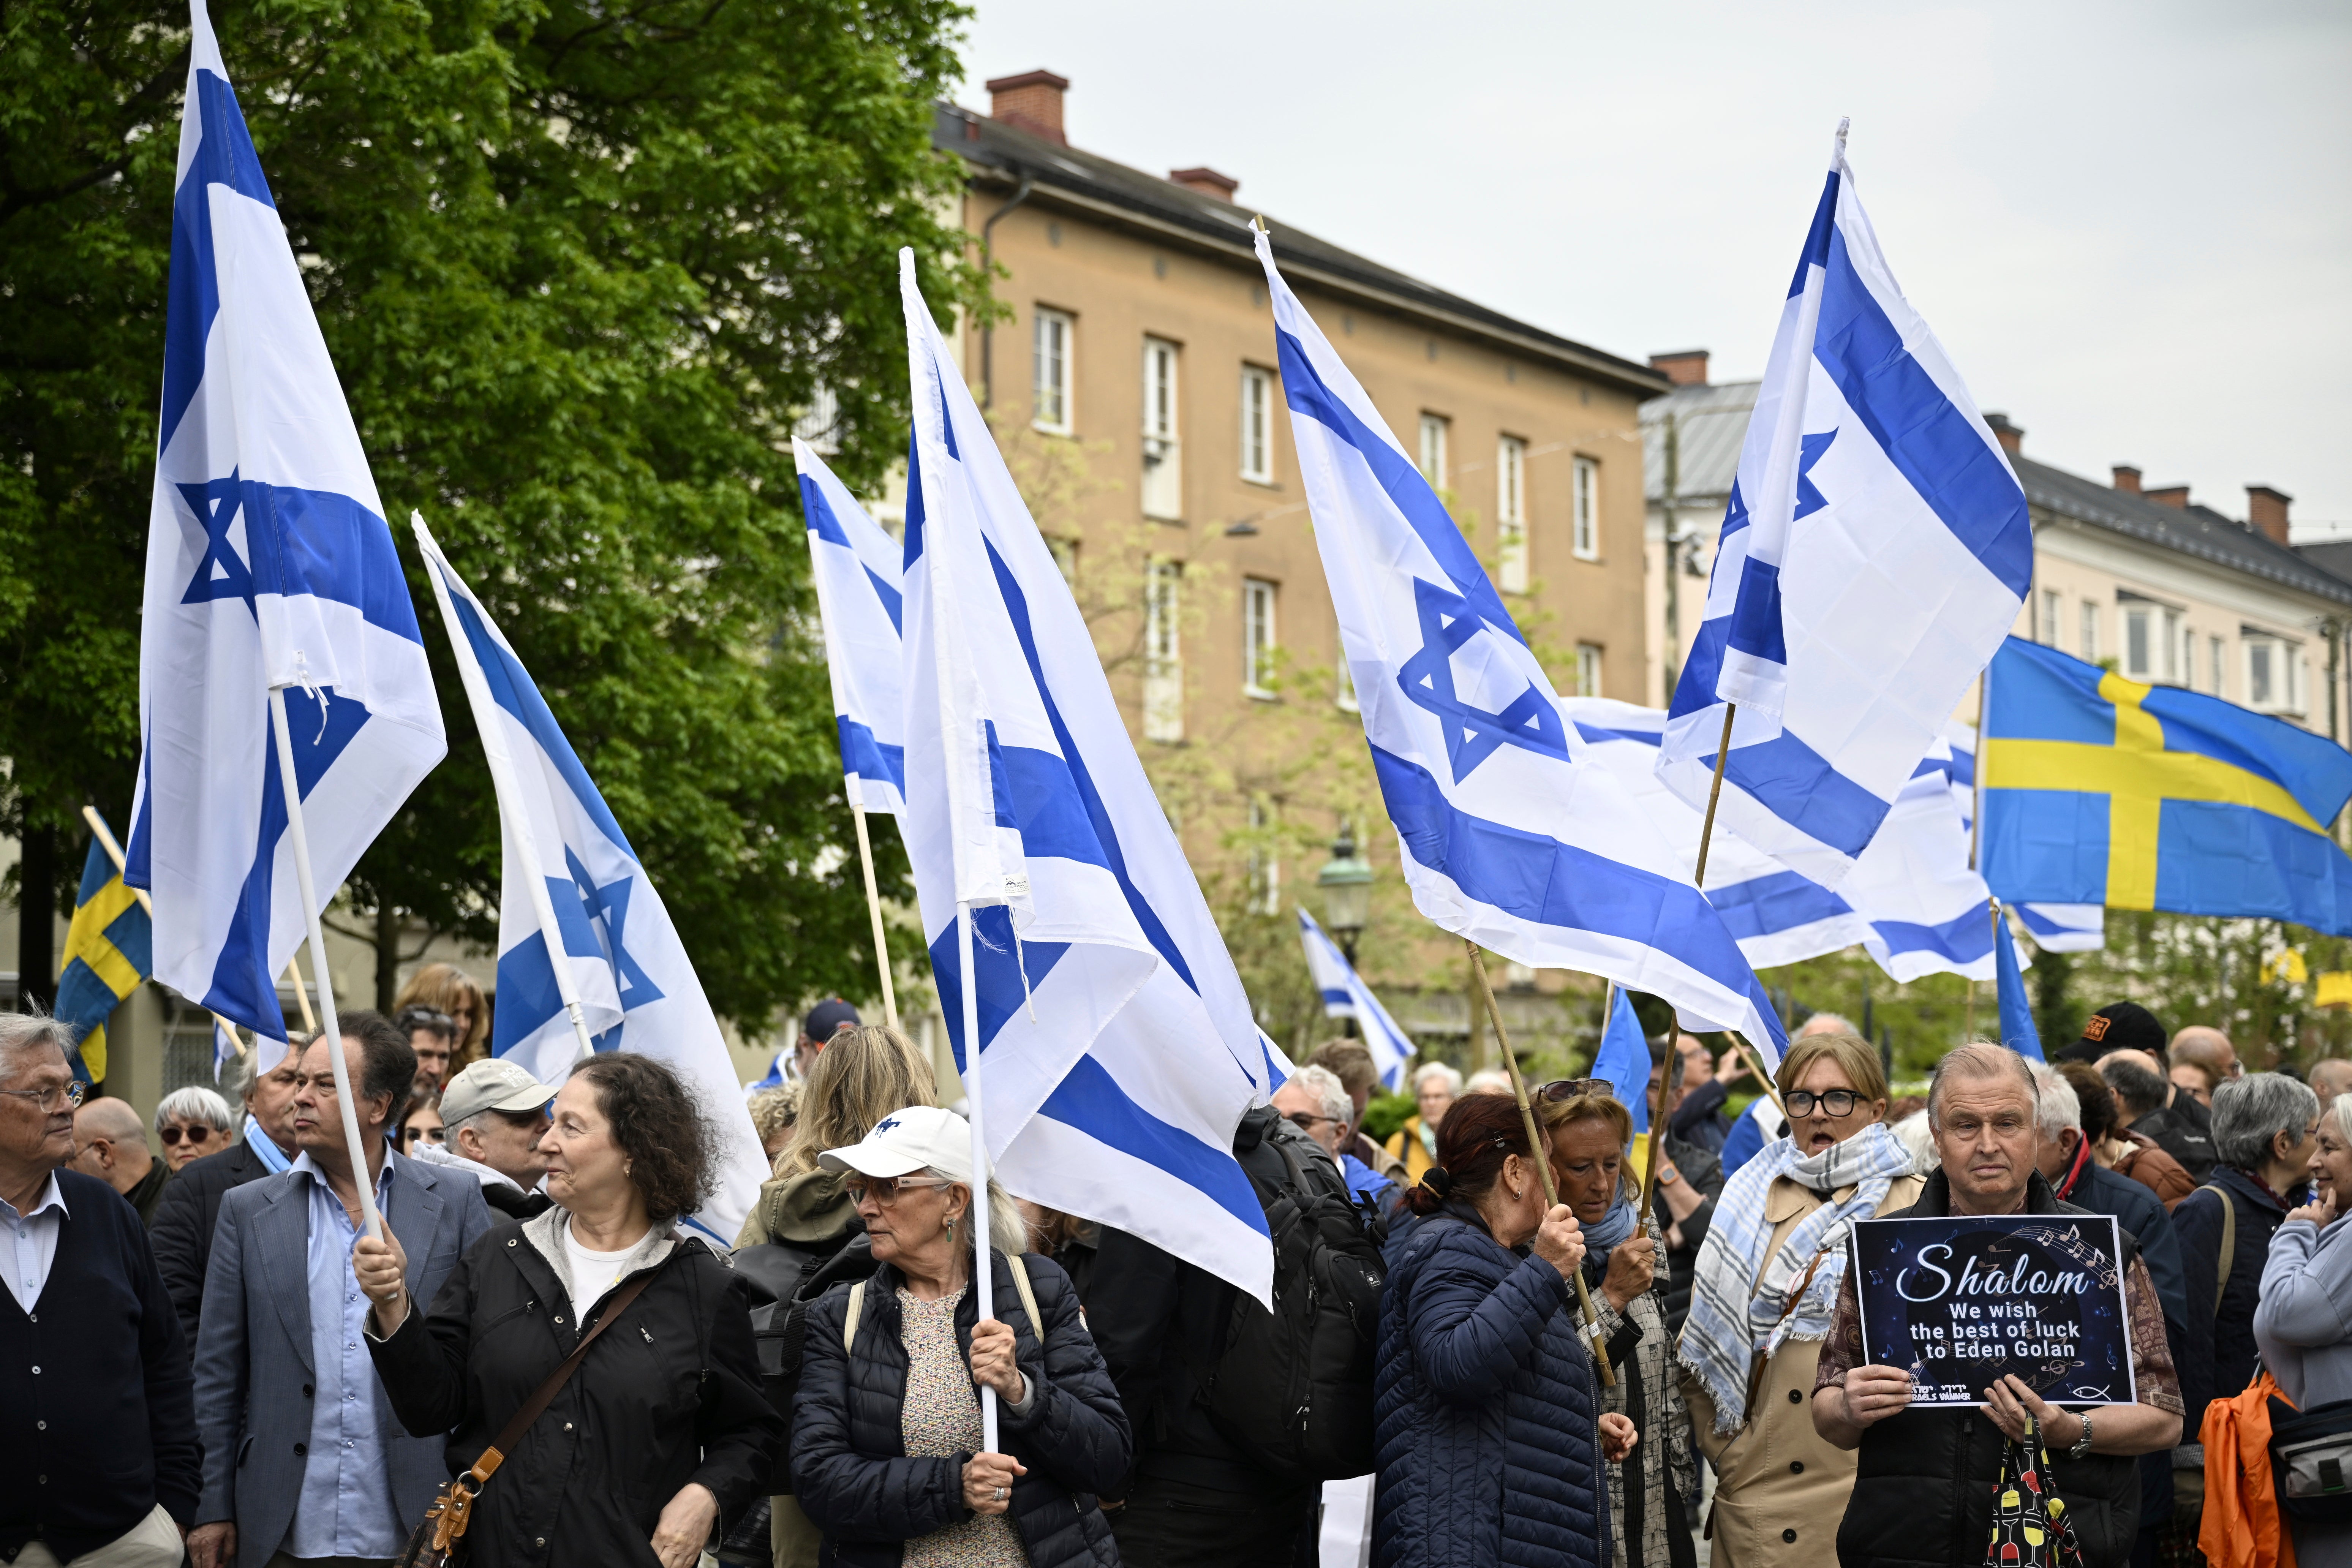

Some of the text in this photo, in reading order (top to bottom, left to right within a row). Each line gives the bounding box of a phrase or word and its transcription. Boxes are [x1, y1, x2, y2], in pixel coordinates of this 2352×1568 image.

[1896, 1244, 2089, 1302] Shalom
[1949, 1301, 2037, 1318] We wish
[1910, 1320, 2080, 1339] the best of luck
[1925, 1340, 2075, 1359] to Eden Golan
[1911, 1384, 1966, 1394] ידידי ישרא
[1912, 1392, 1971, 1401] RAELS VÄNNER
